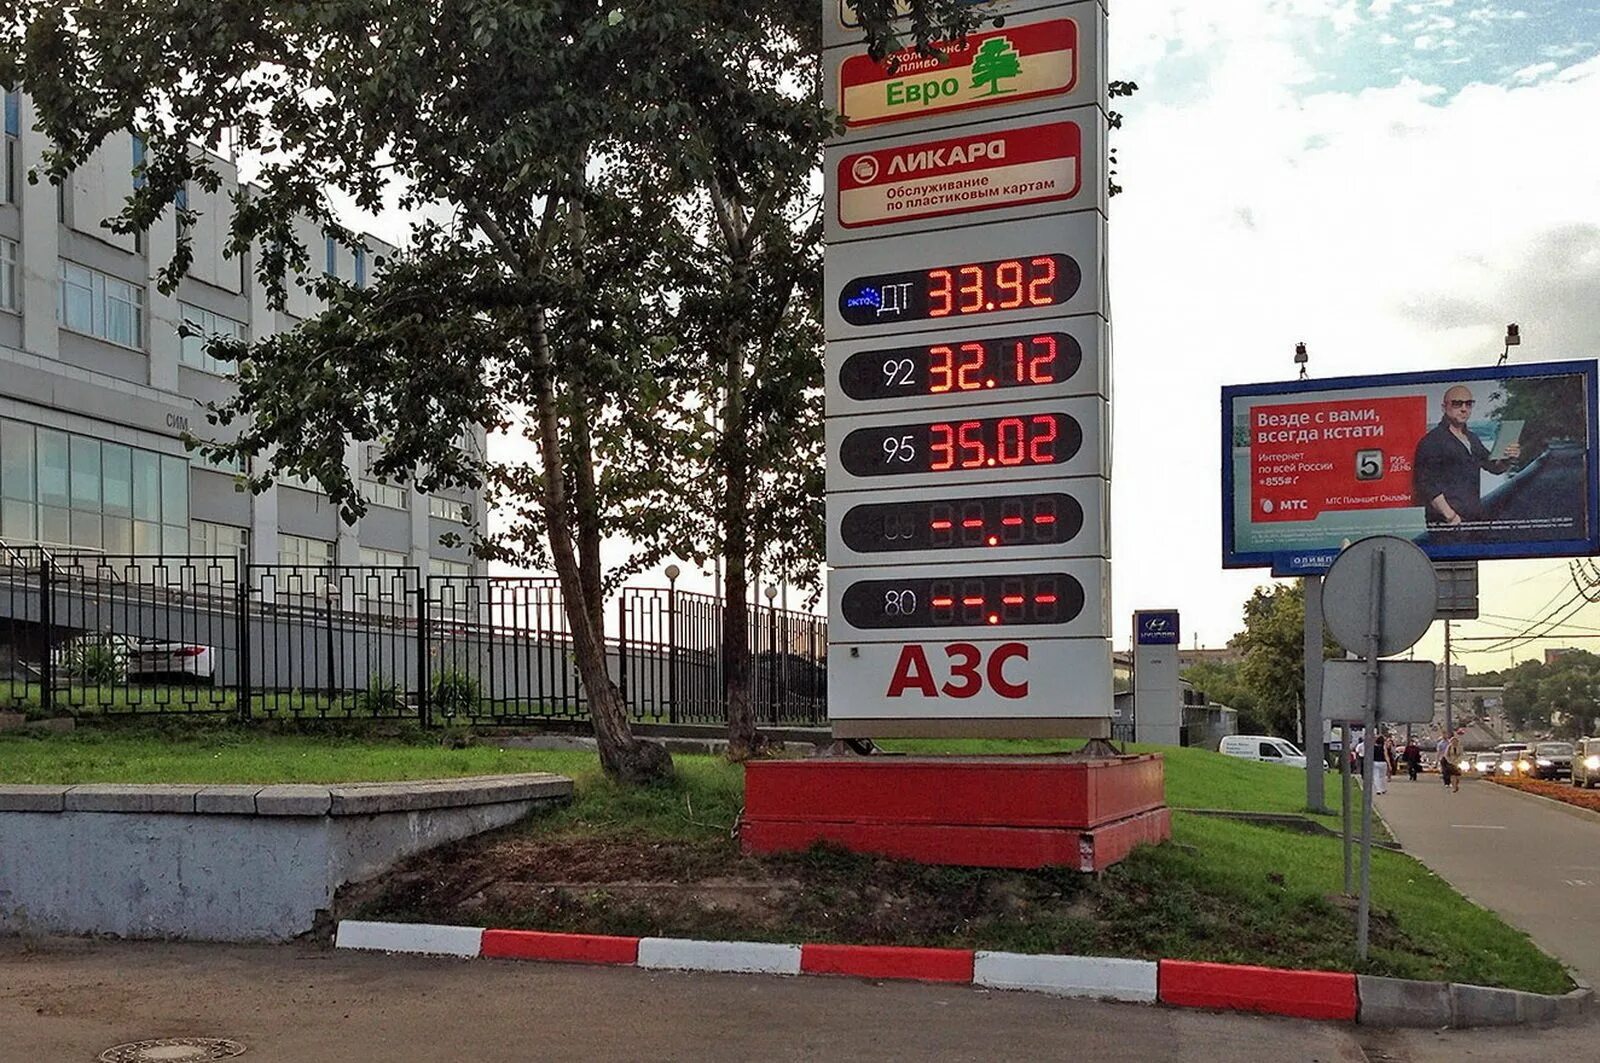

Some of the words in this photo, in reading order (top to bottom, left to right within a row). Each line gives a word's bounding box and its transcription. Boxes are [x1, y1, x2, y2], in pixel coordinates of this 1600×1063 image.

[886, 77, 959, 106] Евро
[886, 176, 989, 199] Обслуживание
[886, 200, 903, 211] по
[905, 185, 1000, 208] пластиковым
[1002, 179, 1055, 196] картам
[876, 282, 914, 317] ДТ
[928, 256, 1056, 318] 33.92
[882, 358, 916, 387] 92
[929, 335, 1057, 393] 32.12
[1257, 411, 1310, 428] Везде
[1315, 411, 1324, 423] с
[1329, 408, 1380, 423] вами,
[882, 435, 916, 464] 95
[929, 414, 1057, 471] 35.02
[1257, 428, 1319, 444] всегда
[1323, 424, 1384, 440] кстати
[1257, 466, 1270, 475] по
[1273, 462, 1297, 473] всей
[1298, 462, 1334, 473] России
[1258, 451, 1305, 463] Интернет
[1360, 453, 1380, 477] 5
[1280, 499, 1308, 510] МТС
[1325, 497, 1342, 505] МТС
[1343, 495, 1379, 505] Планшет
[1379, 493, 1412, 502] Онлайн
[884, 589, 917, 617] 80
[886, 642, 1029, 699] АЗС
